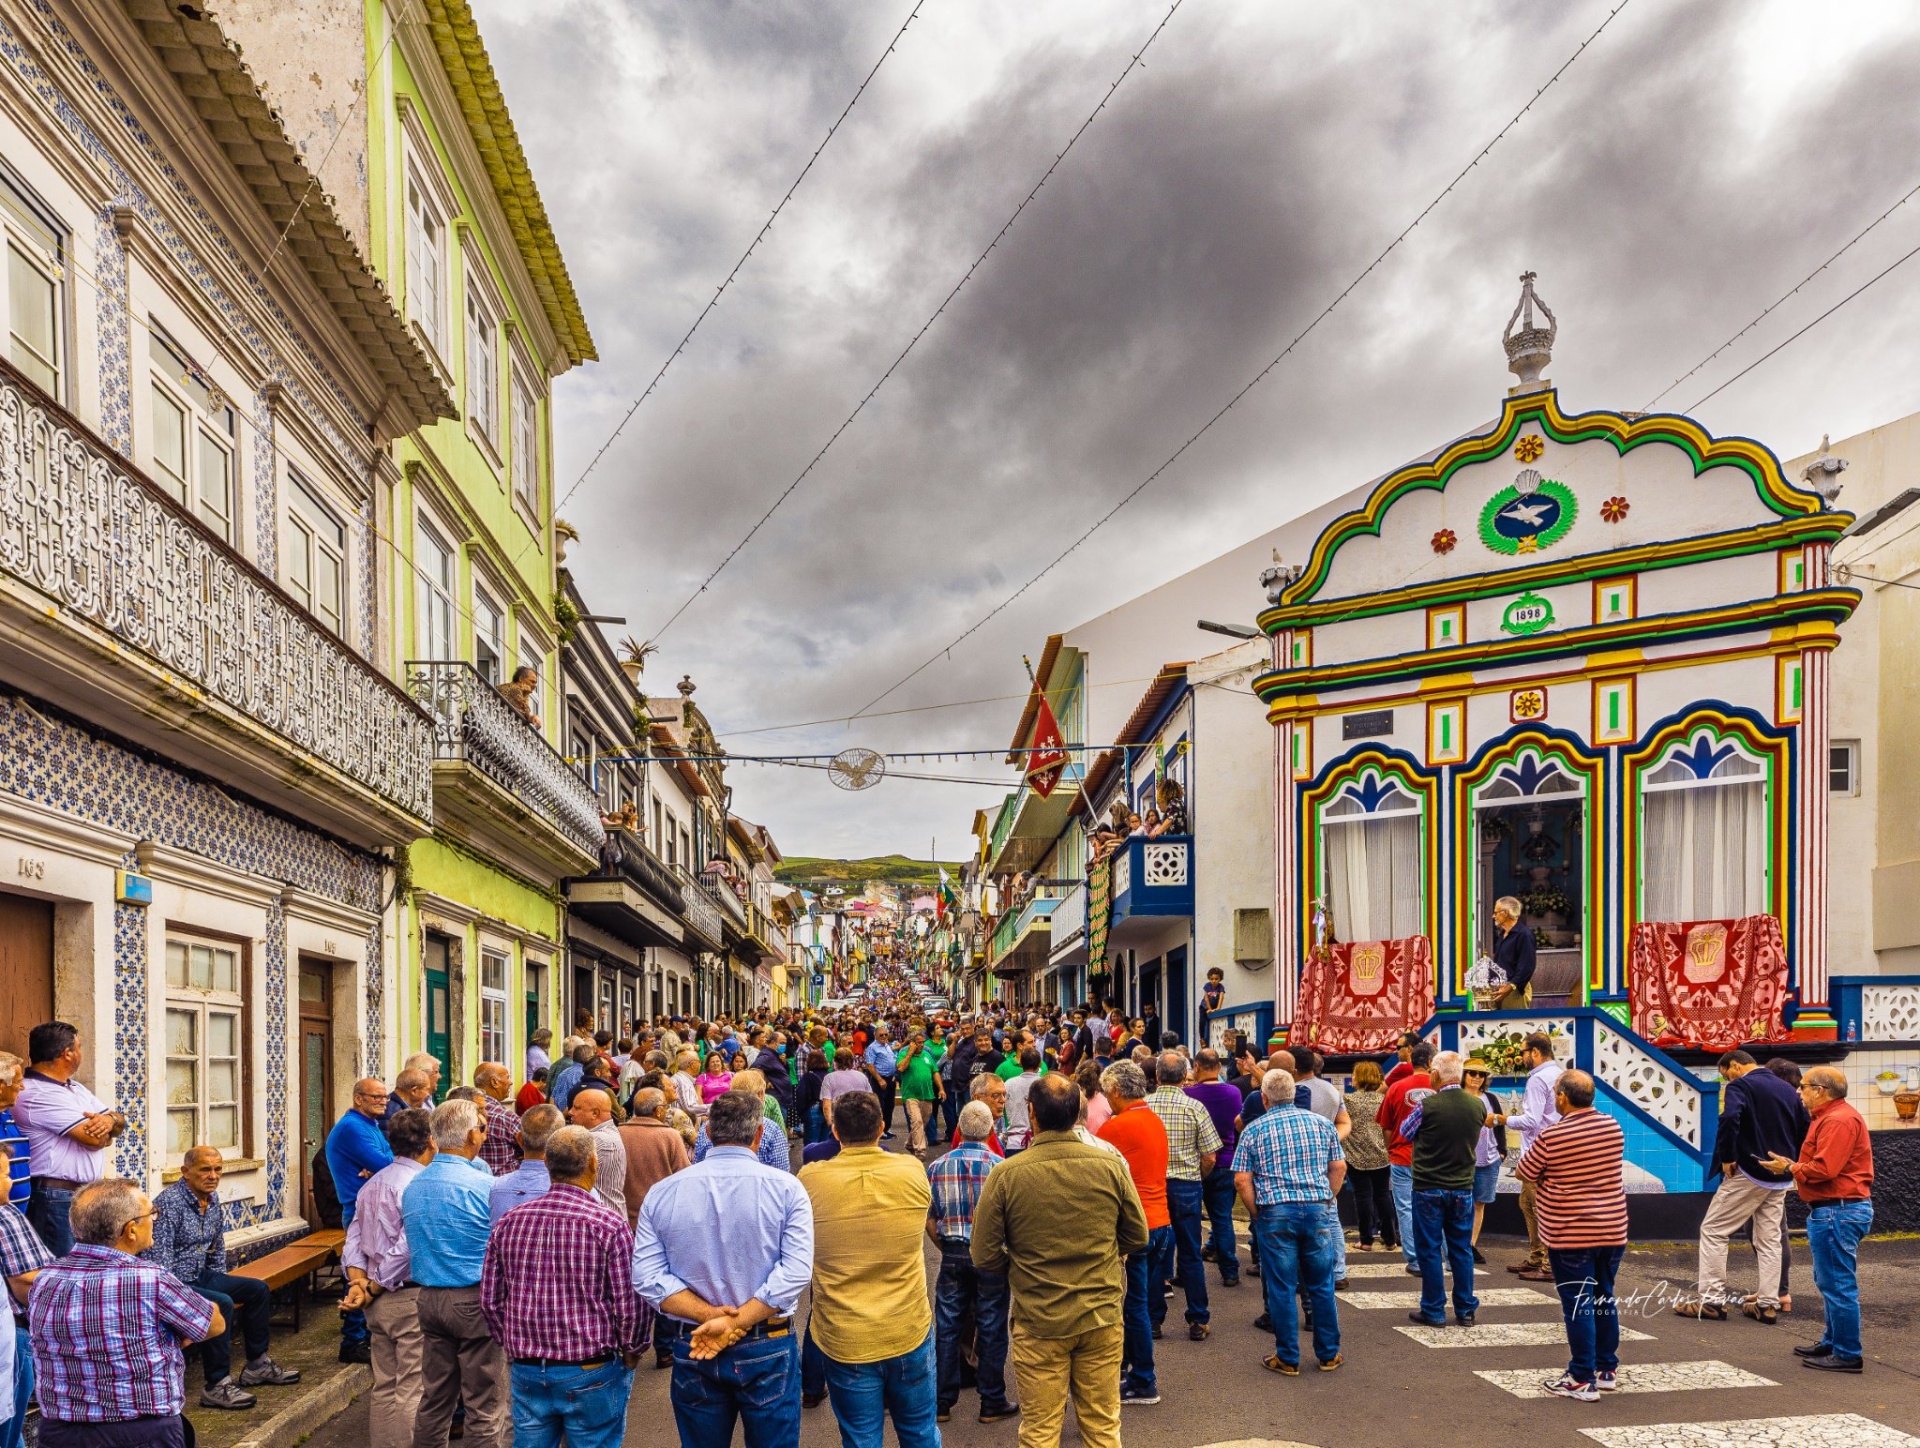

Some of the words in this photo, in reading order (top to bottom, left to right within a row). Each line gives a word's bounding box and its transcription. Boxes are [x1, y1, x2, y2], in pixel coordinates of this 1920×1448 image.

[1516, 608, 1541, 621] 1898
[18, 857, 45, 880] 163
[814, 975, 822, 985] P
